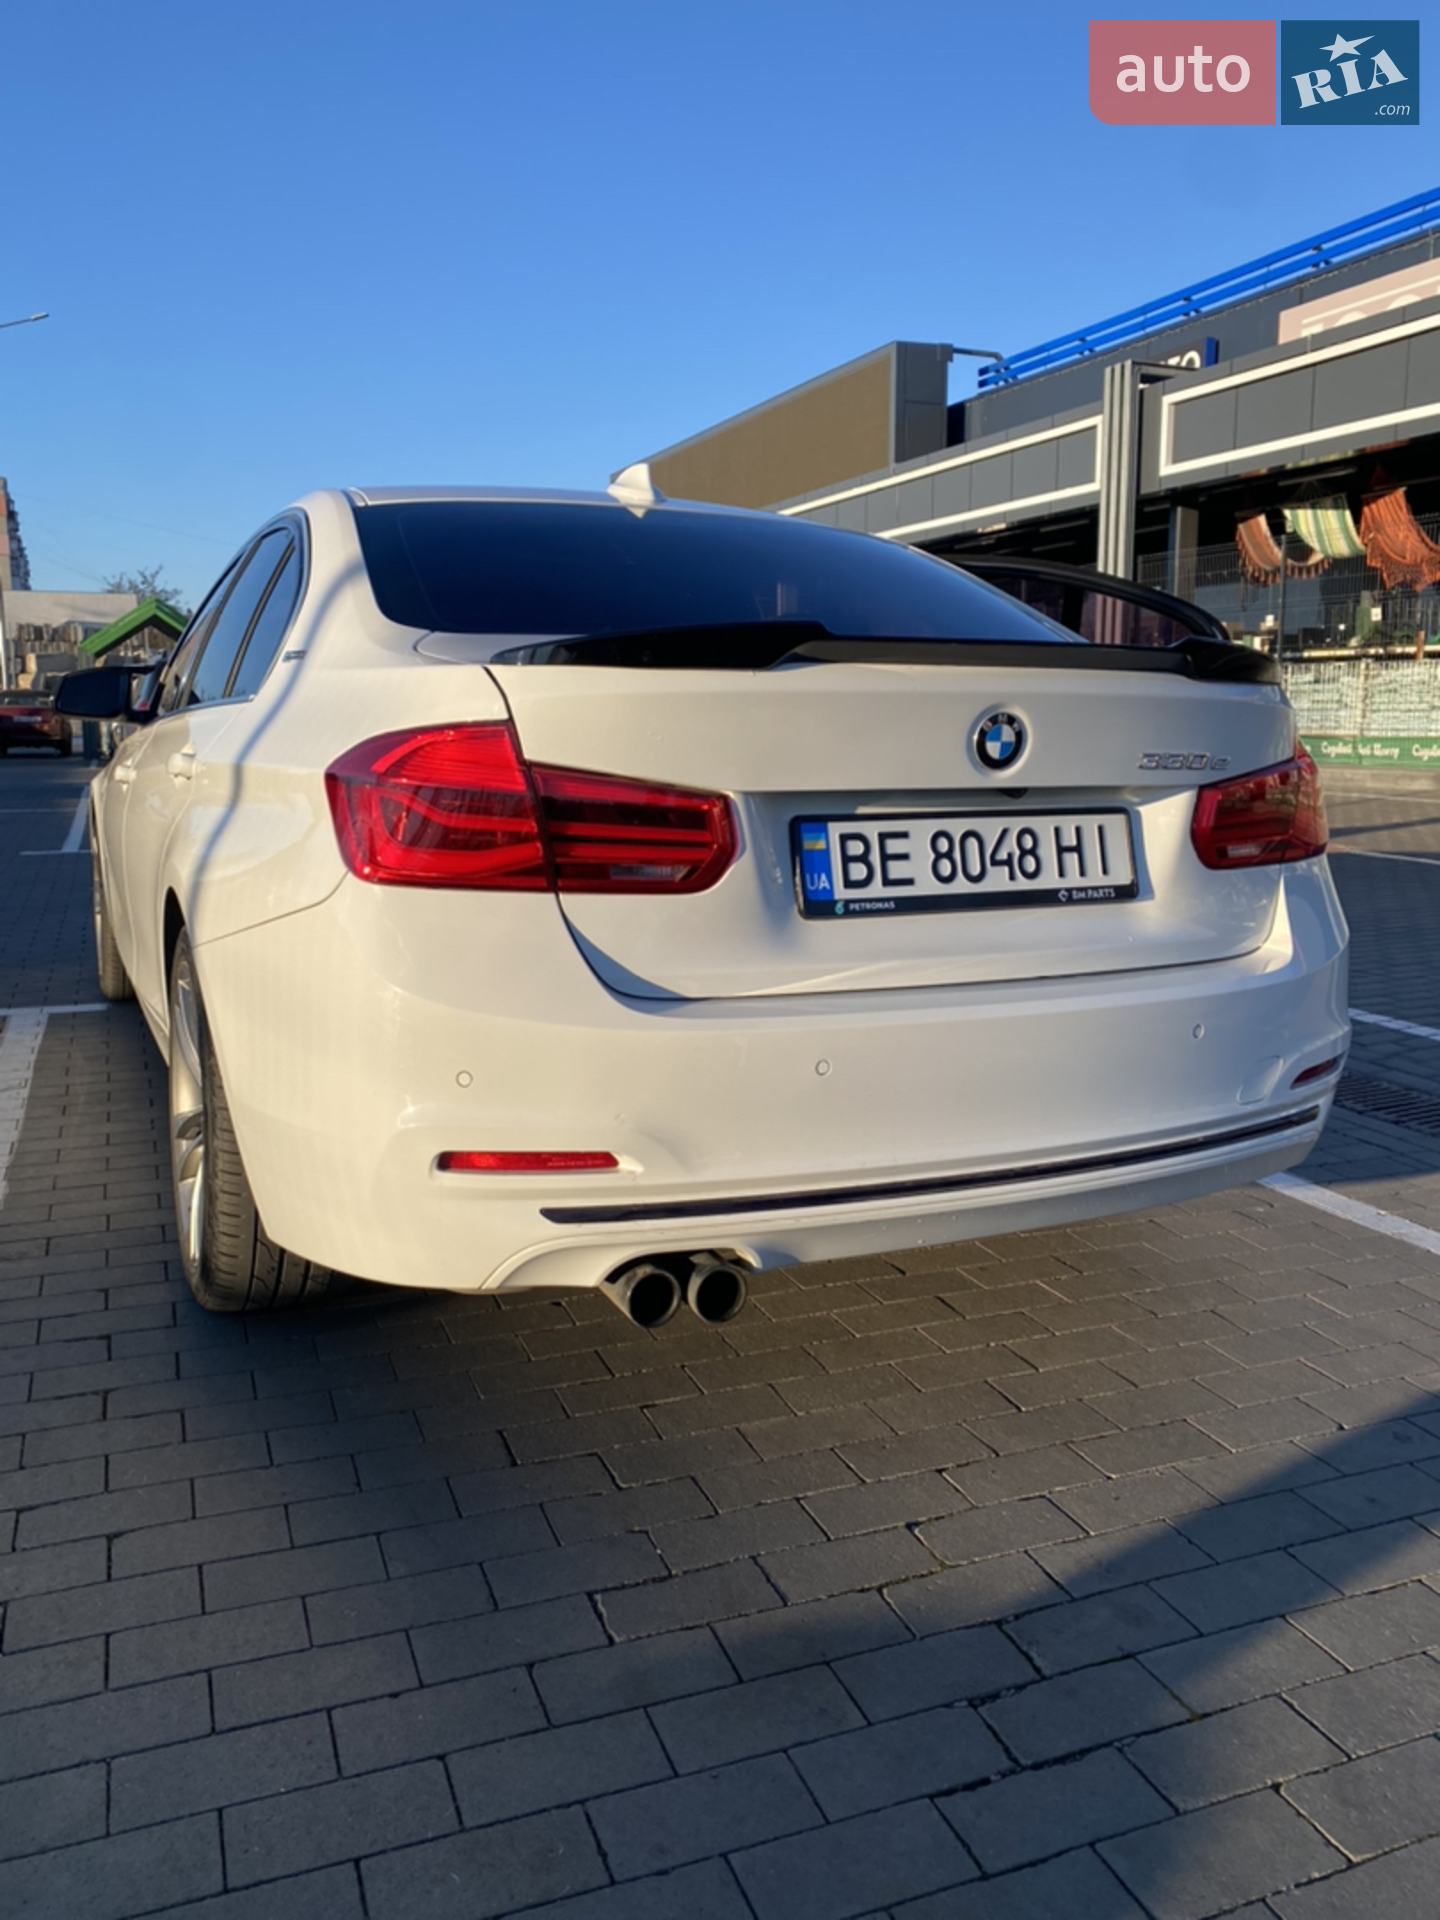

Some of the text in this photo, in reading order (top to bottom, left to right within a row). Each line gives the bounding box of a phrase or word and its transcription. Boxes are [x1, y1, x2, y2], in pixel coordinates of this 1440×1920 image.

[1136, 752, 1231, 770] 330e
[838, 824, 1109, 890] BE 8048 HI
[806, 872, 830, 891] UA
[849, 900, 895, 912] PETRONAS
